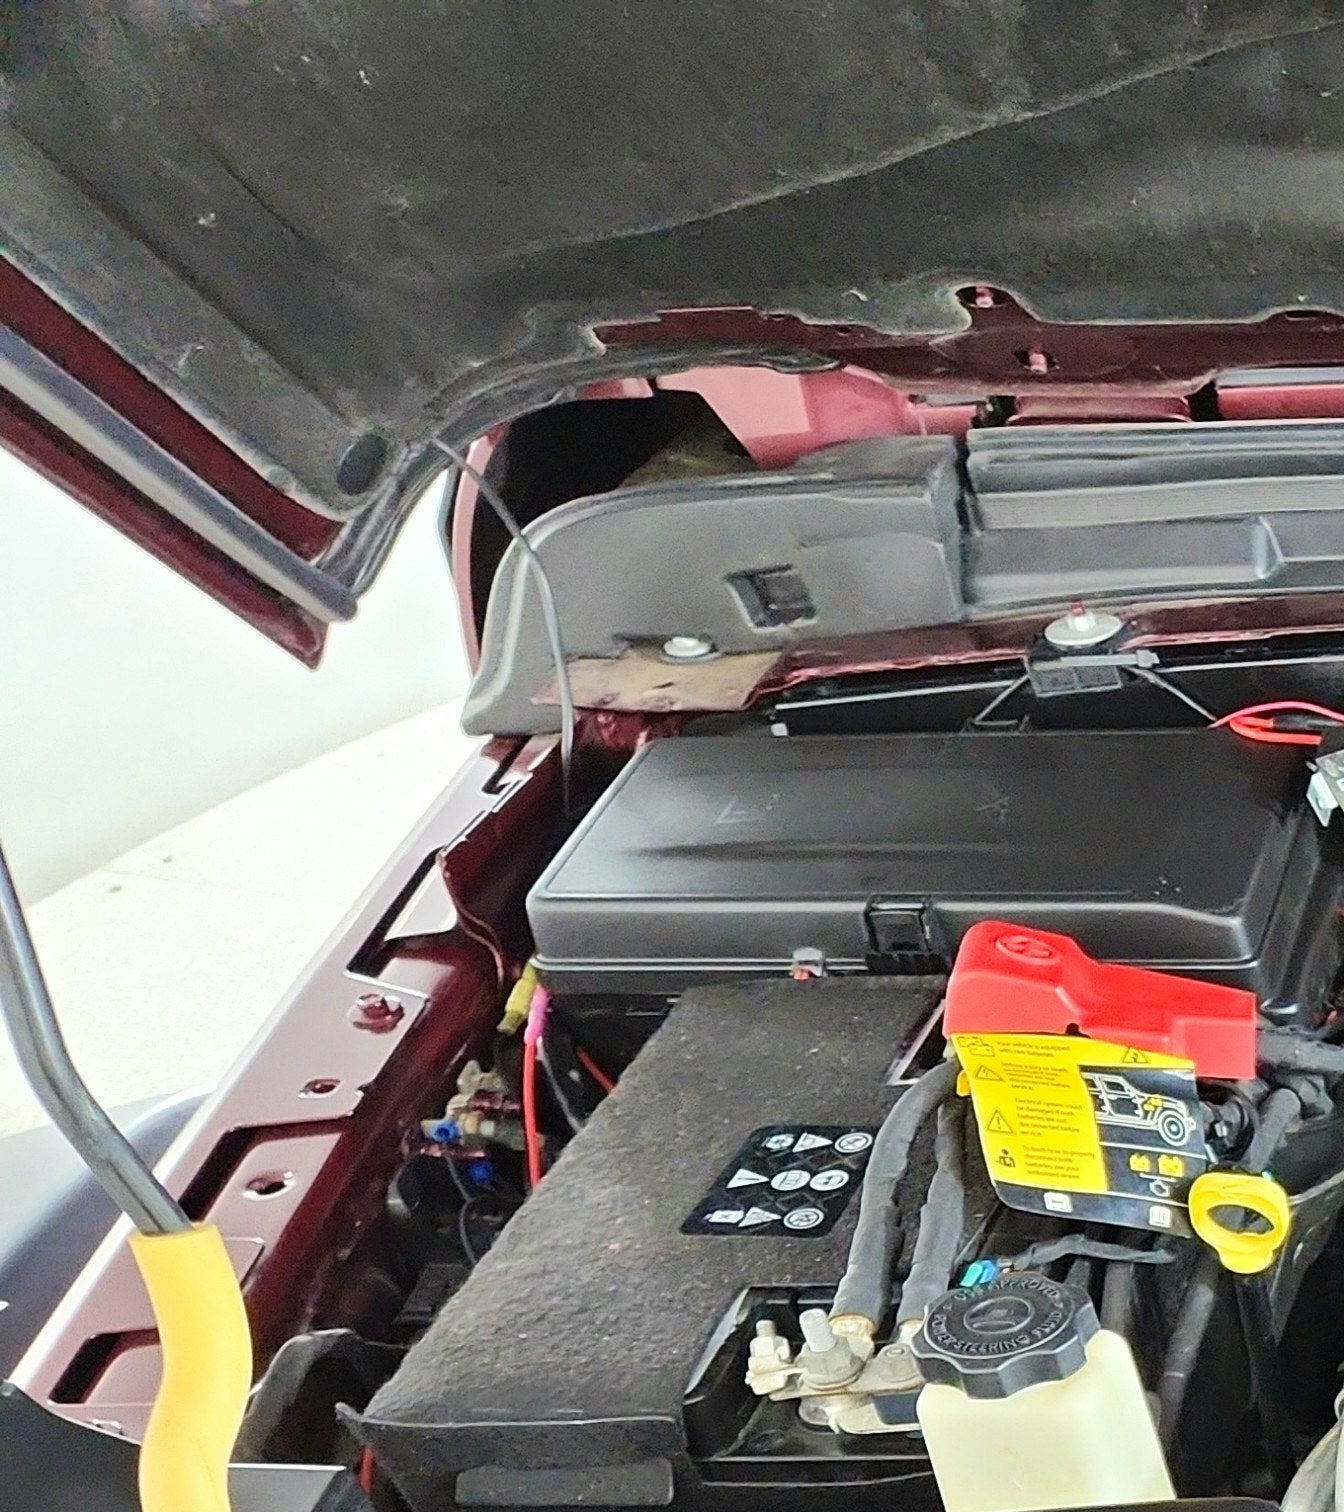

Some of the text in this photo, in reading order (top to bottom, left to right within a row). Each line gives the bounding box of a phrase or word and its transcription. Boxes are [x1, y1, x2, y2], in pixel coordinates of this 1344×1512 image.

[988, 1279, 1060, 1301] APPROVED
[931, 1310, 1062, 1354] POWER STEERING FLUID
